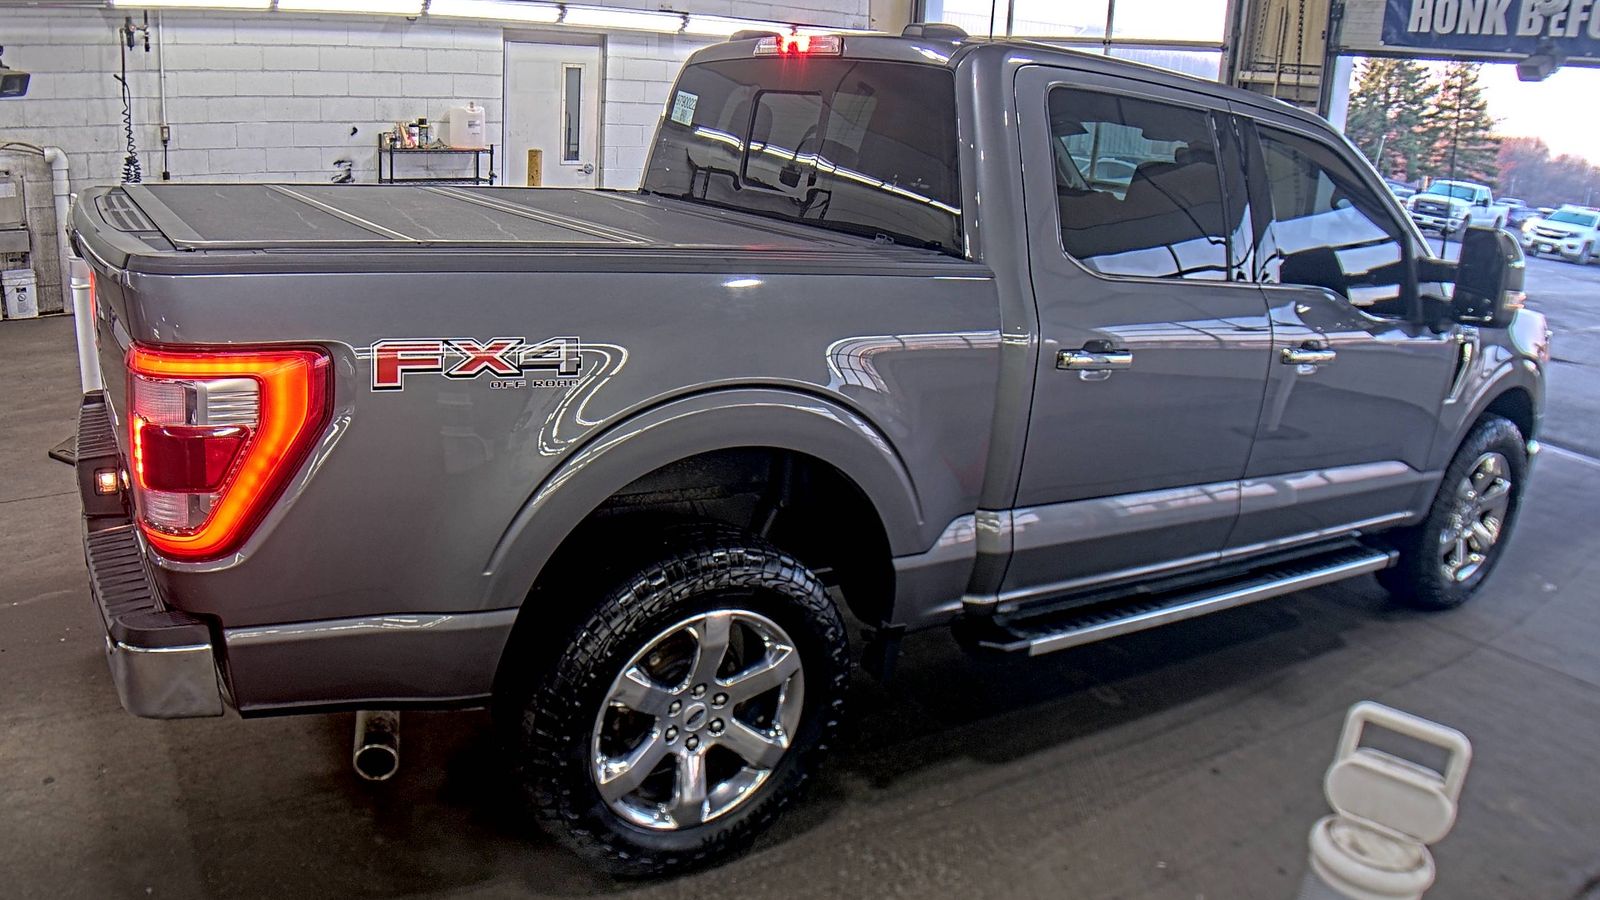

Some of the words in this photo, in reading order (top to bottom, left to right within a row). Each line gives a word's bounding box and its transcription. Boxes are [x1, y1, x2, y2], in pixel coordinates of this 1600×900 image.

[1408, 0, 1511, 34] HONK
[371, 337, 583, 391] FX4
[490, 381, 526, 389] OFF
[532, 379, 579, 388] ROAD
